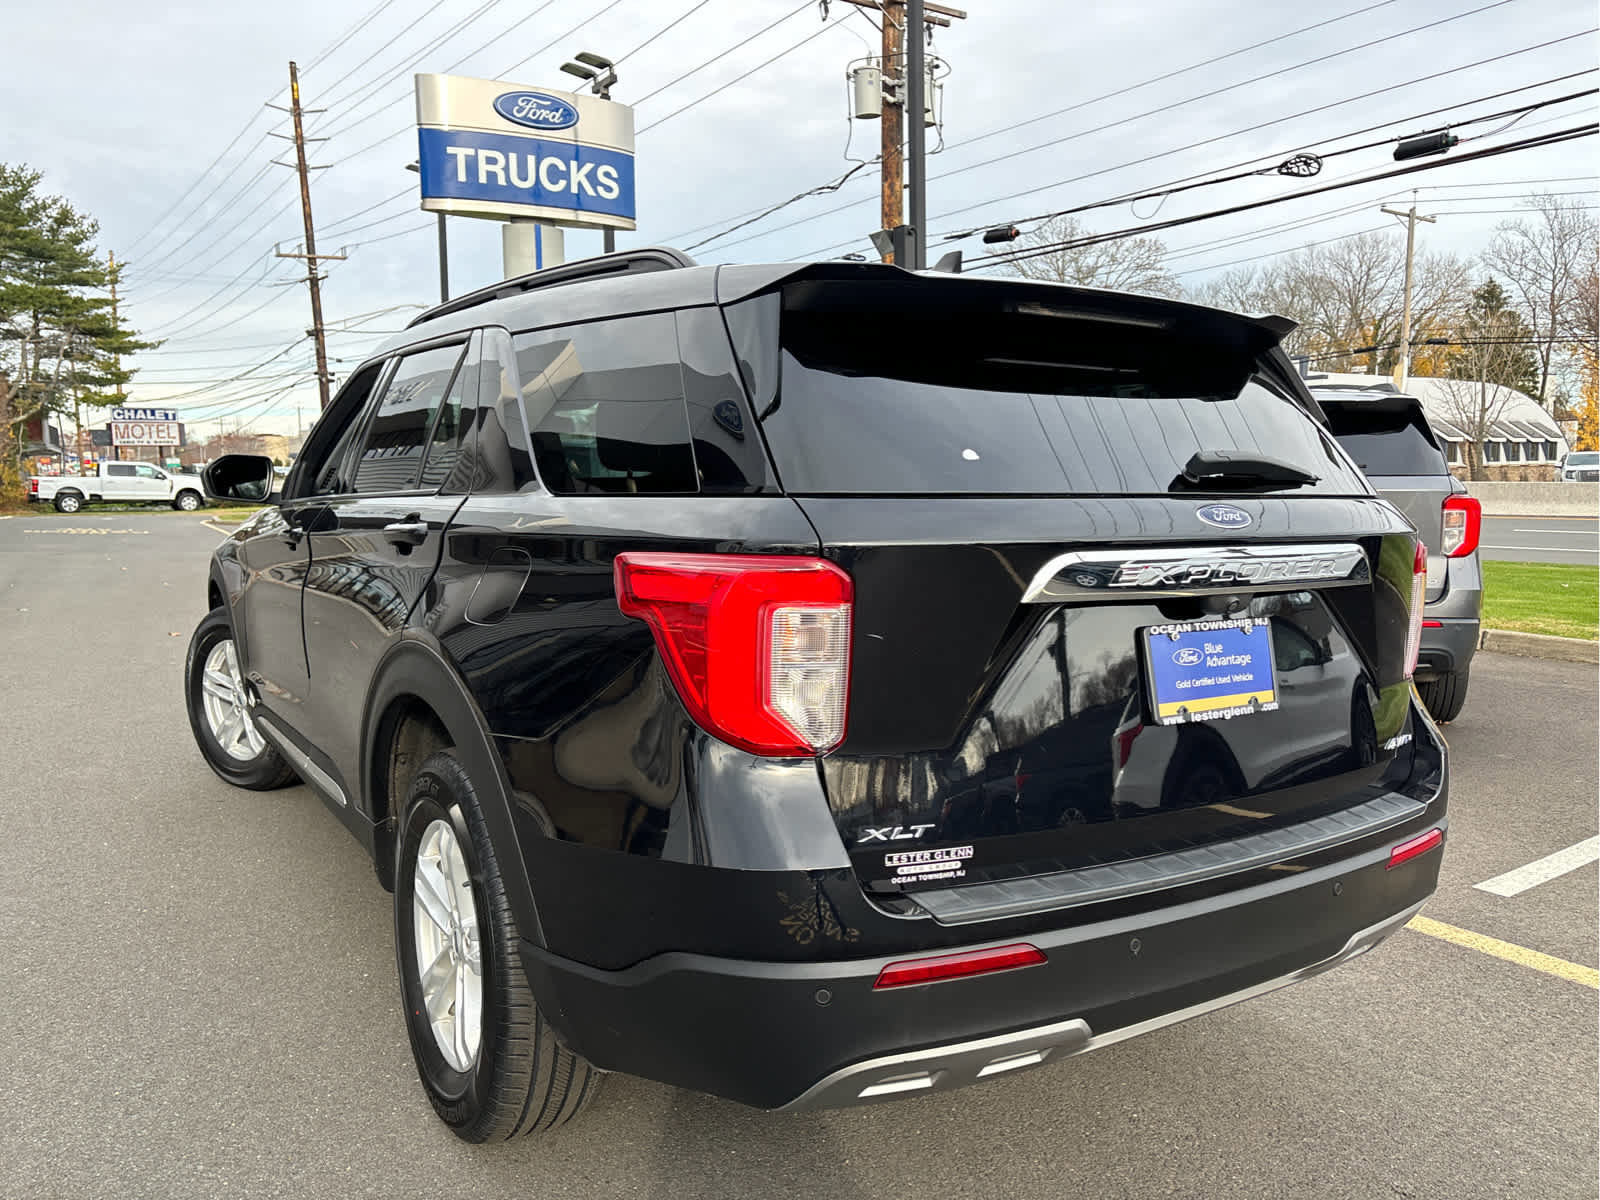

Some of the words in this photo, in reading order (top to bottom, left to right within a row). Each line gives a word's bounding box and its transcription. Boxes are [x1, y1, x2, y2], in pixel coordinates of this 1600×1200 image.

[512, 96, 564, 124] Ford
[446, 146, 620, 200] TRUCKS
[113, 409, 176, 420] CHALET
[114, 423, 177, 439] MOTEL
[1108, 559, 1338, 587] EXPLORER
[1150, 623, 1192, 635] OCEAN
[1254, 617, 1269, 626] NJ
[1203, 642, 1223, 654] Blue
[1206, 654, 1252, 667] Advantage
[1175, 680, 1191, 689] Gold
[1191, 677, 1215, 687] Certified
[1215, 675, 1231, 684] Used
[1231, 672, 1254, 682] Vehicle
[856, 823, 936, 843] XLT
[885, 852, 931, 865] LESTER
[934, 847, 974, 859] GLENN
[891, 875, 917, 884] OCEAN
